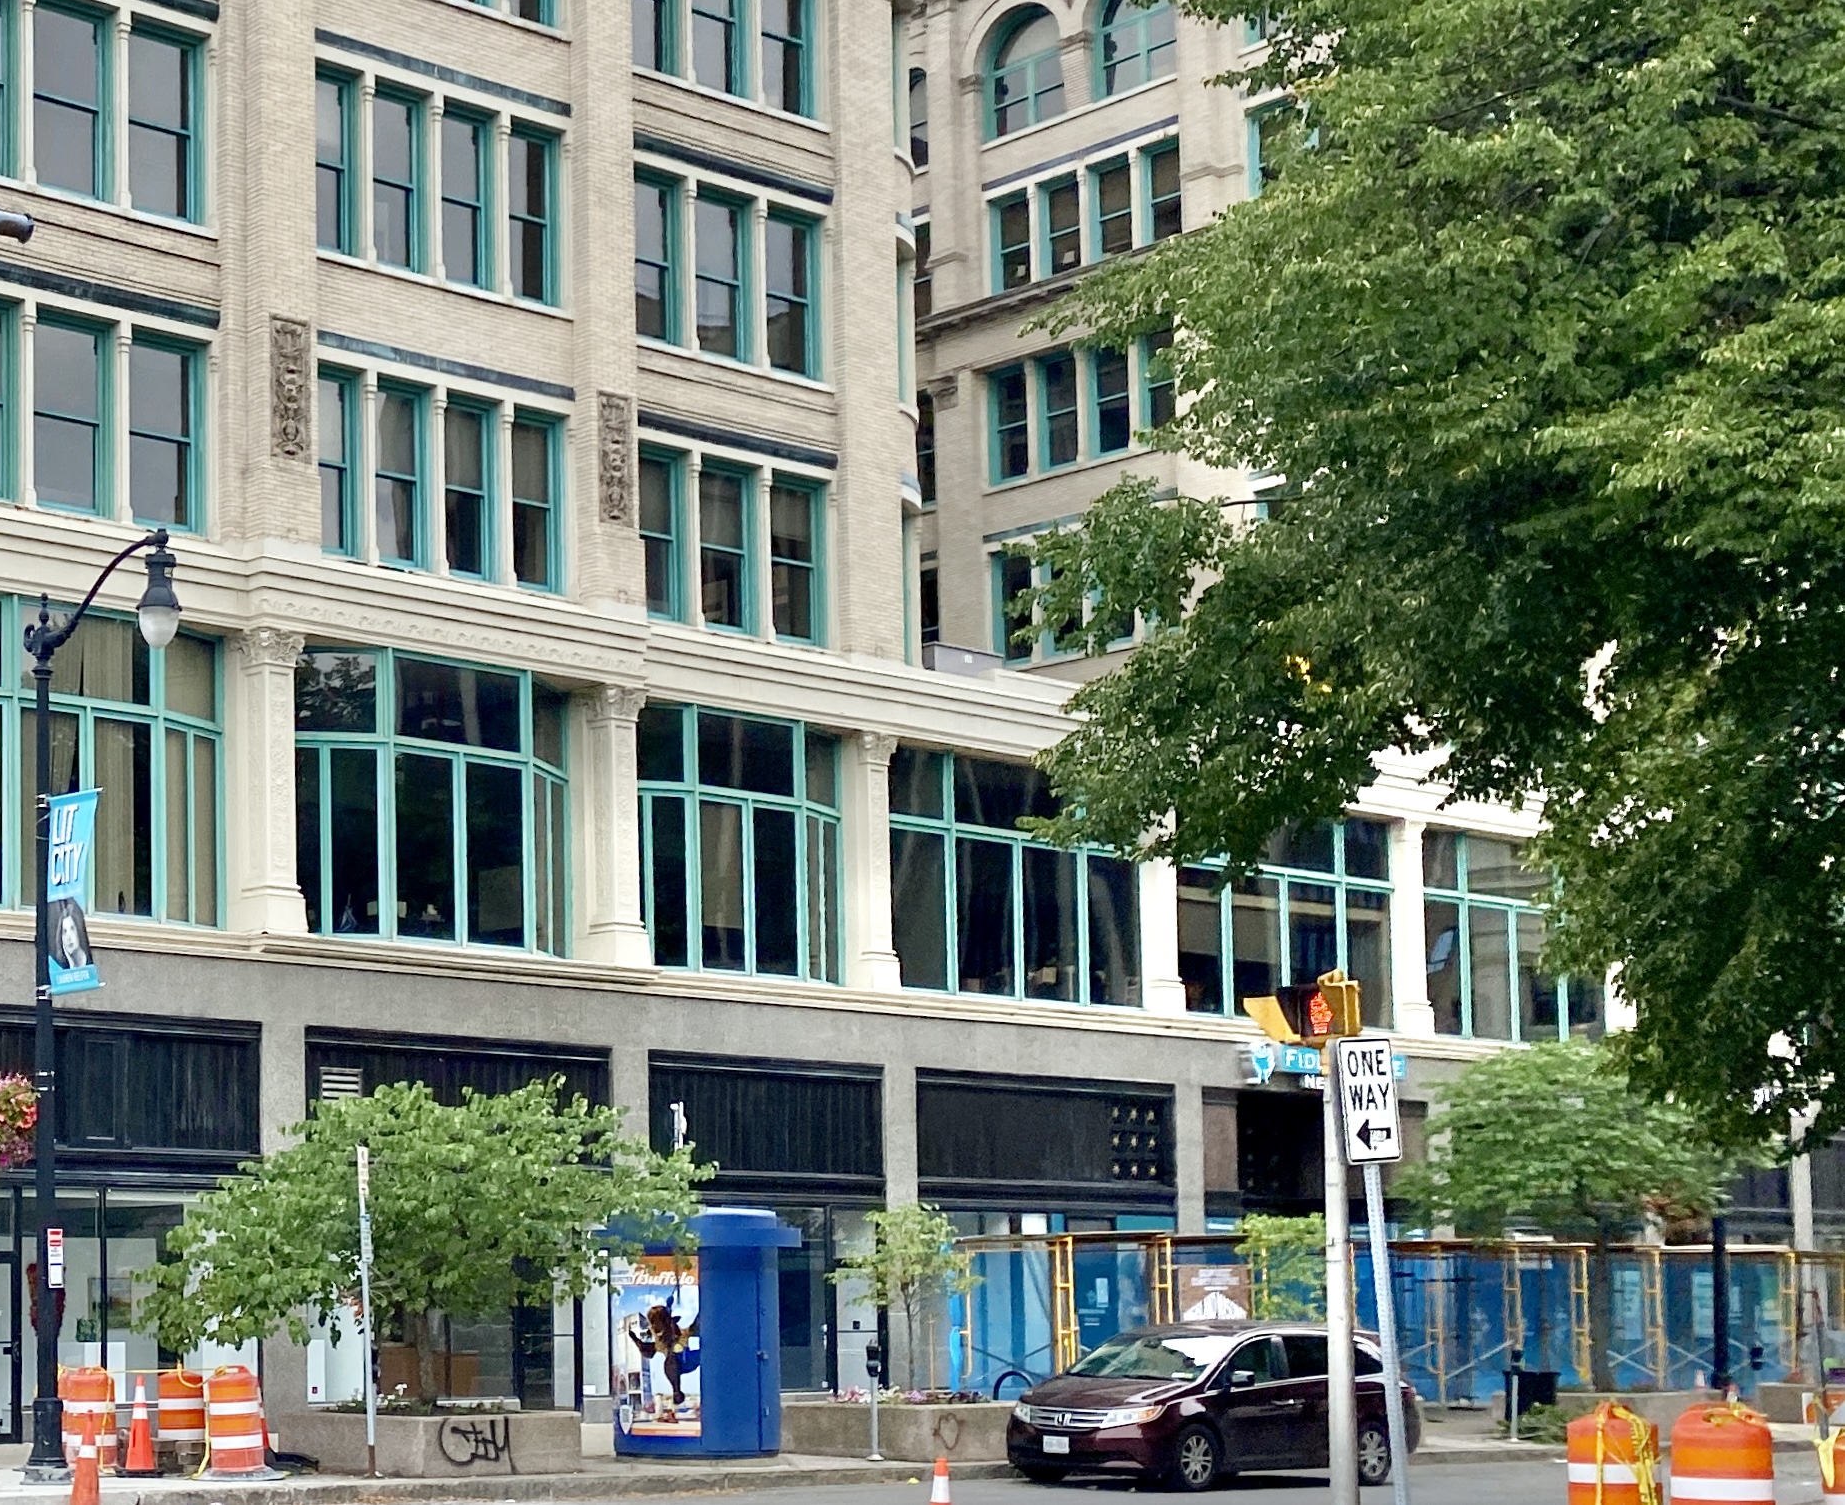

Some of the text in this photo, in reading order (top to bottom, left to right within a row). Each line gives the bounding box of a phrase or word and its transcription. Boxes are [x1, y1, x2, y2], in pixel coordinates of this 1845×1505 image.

[52, 803, 79, 845] LIT
[51, 843, 84, 886] CITY
[1347, 1049, 1387, 1077] ONE
[1349, 1083, 1390, 1111] WAY
